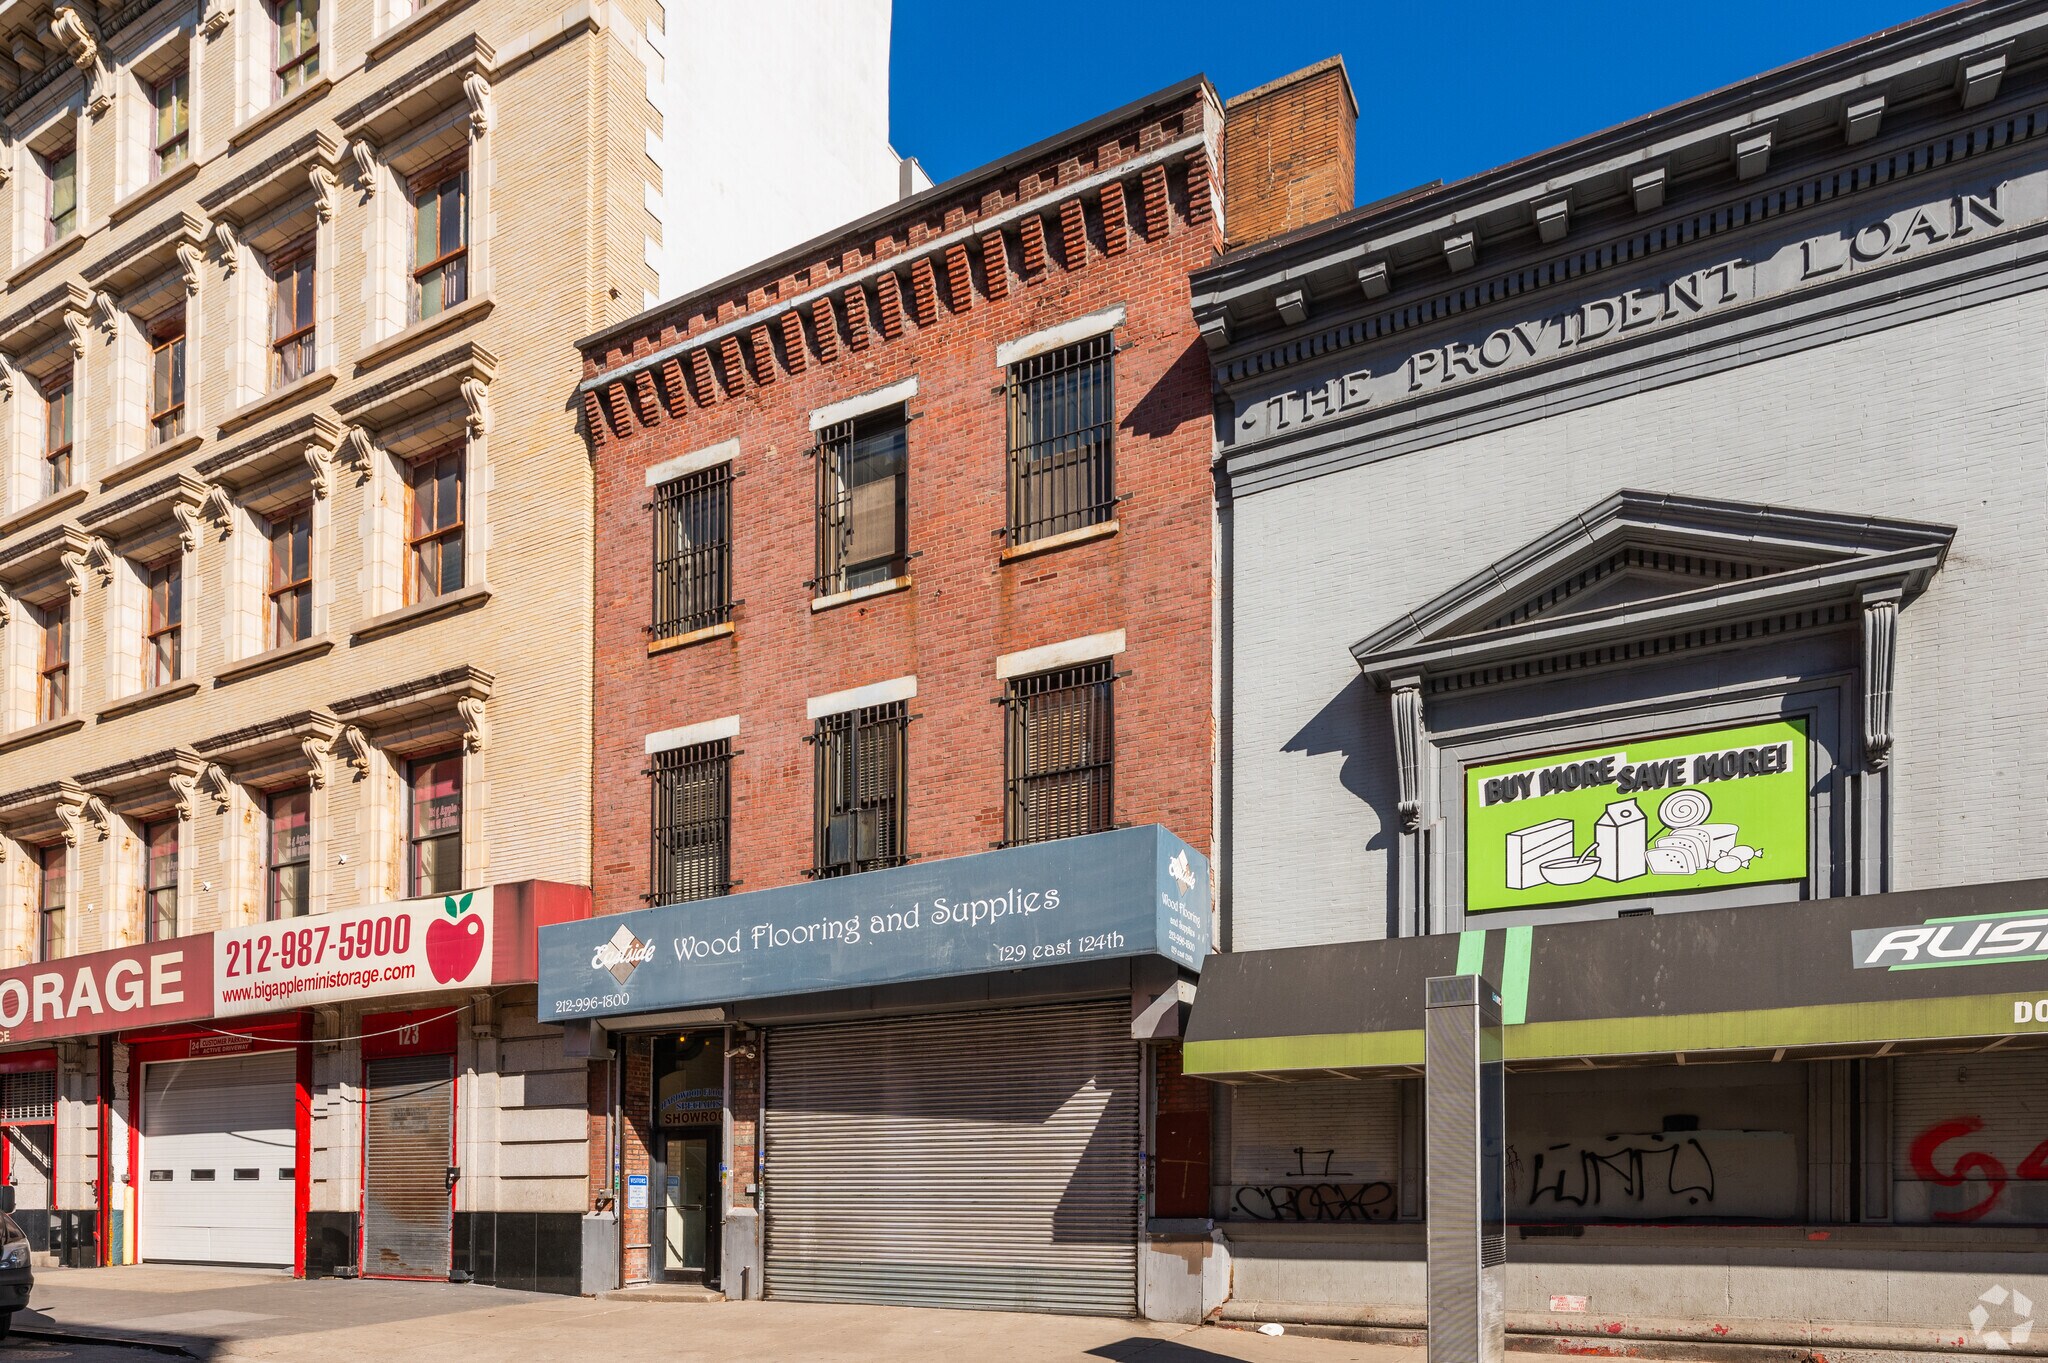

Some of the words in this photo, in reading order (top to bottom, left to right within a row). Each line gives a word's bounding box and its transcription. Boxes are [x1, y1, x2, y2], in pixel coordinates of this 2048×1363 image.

[1267, 369, 1374, 429] THE
[1408, 257, 1752, 392] PROVIDENT
[1800, 180, 2008, 281] LOAN
[1484, 771, 1535, 805] BUY
[1539, 755, 1616, 796] MORE
[1616, 758, 1687, 794] SAVE
[1692, 743, 1788, 780] MORE!
[674, 929, 741, 961] Wood
[751, 916, 860, 949] Flooring
[870, 902, 920, 934] and
[931, 888, 1060, 927] Supplies
[1162, 892, 1178, 912] Wood
[1179, 902, 1200, 928] Flooring
[226, 914, 411, 978] 212-987-5900
[591, 939, 656, 969] Eastside
[999, 944, 1027, 962] 129
[1032, 939, 1072, 960] east
[1079, 931, 1124, 953] 124th
[0, 950, 184, 1029] ORAGE
[222, 964, 416, 1003] www.bigappleministorage.com
[555, 993, 630, 1013] 212-996-1800
[191, 1041, 200, 1050] 24
[202, 1038, 227, 1047] CUSTOMER
[202, 1046, 222, 1054] ACTIVE
[222, 1044, 249, 1052] DRIVEWAY
[399, 1024, 419, 1046] 123
[664, 1111, 723, 1124] SHOWROO
[676, 1100, 723, 1111] SPECIALIS
